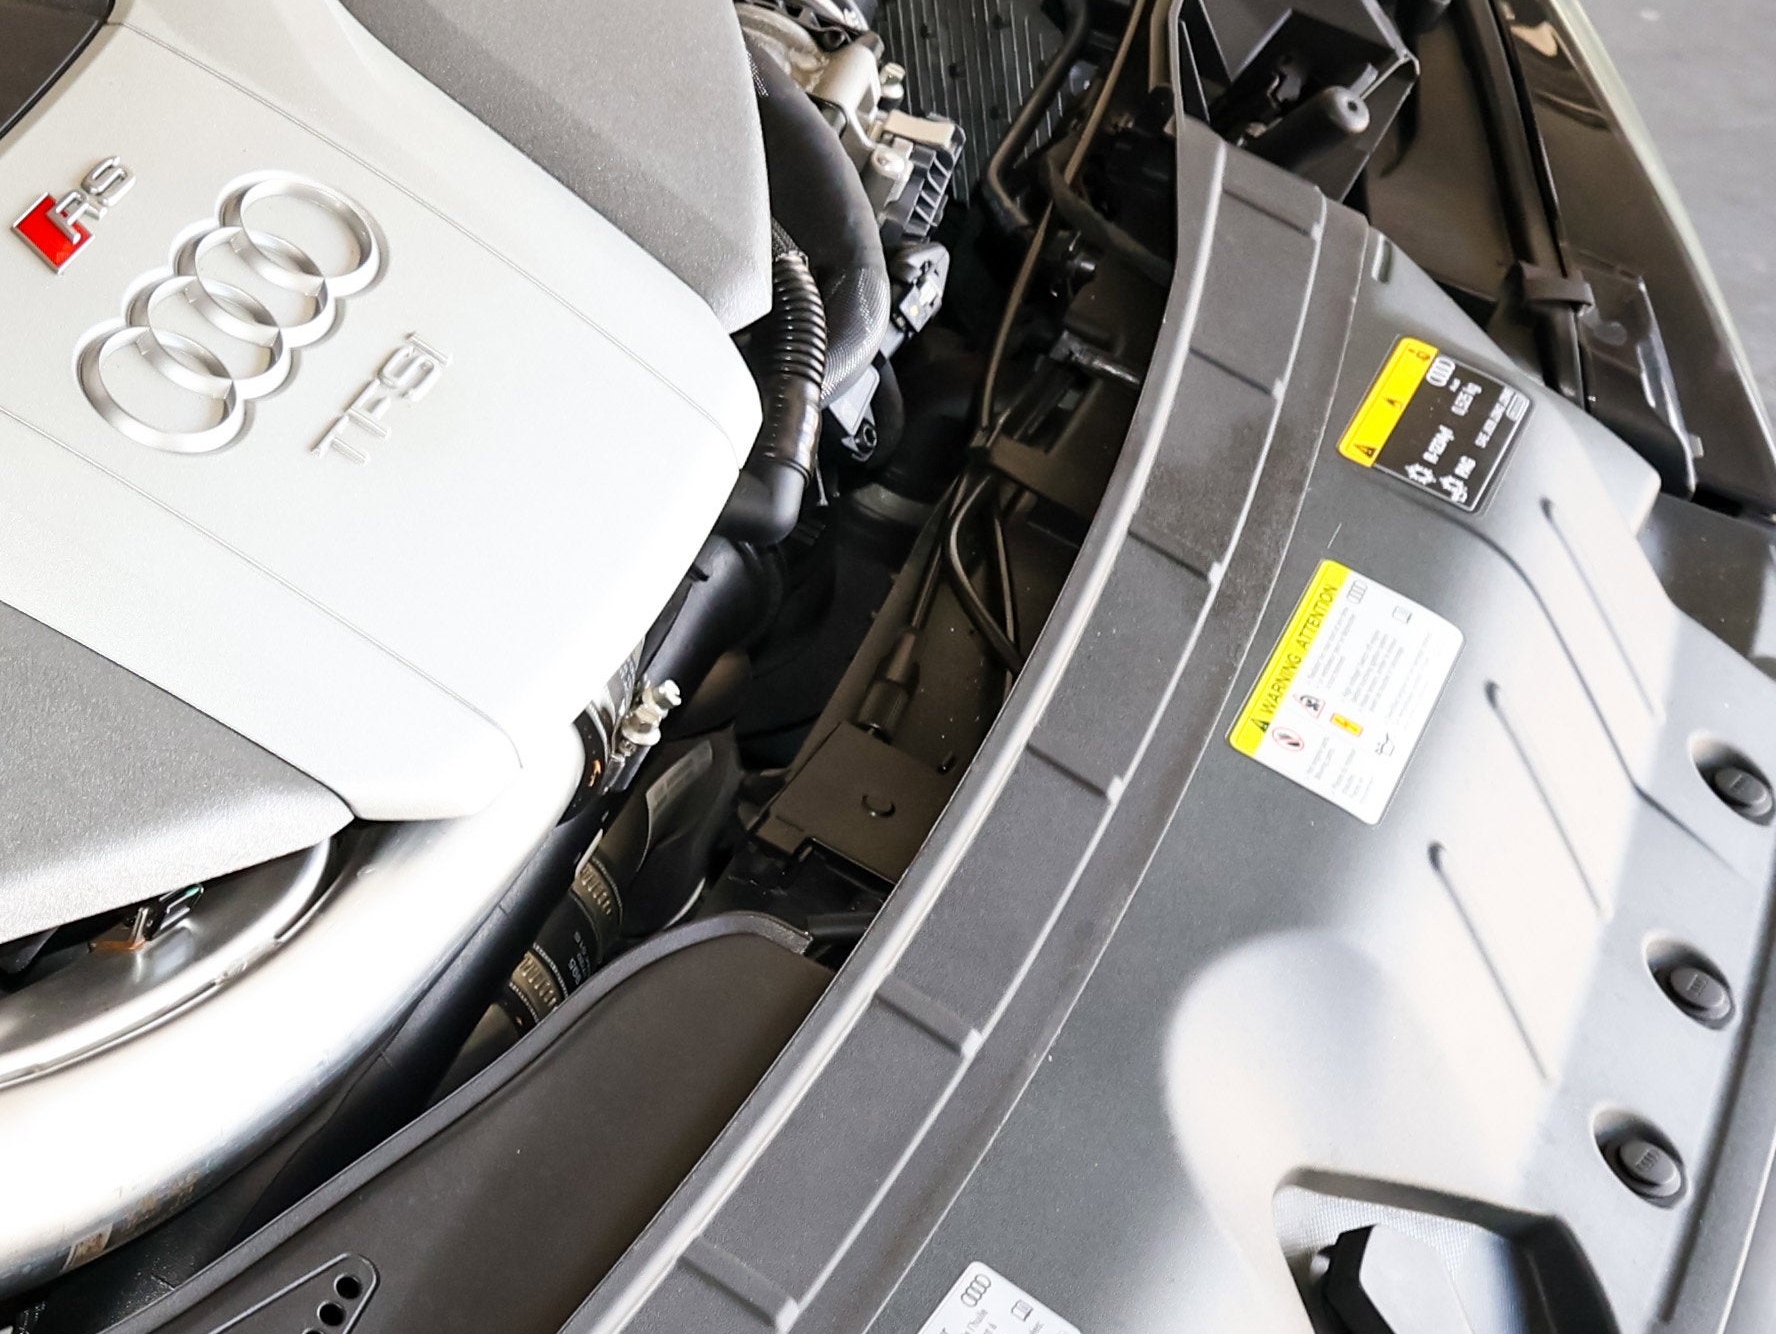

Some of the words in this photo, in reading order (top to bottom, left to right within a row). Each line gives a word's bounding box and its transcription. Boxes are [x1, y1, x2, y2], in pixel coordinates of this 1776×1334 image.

[46, 155, 137, 244] RS
[306, 330, 454, 464] TFSI
[1261, 653, 1300, 715] WARNING
[1296, 583, 1336, 647] ATTENTION
